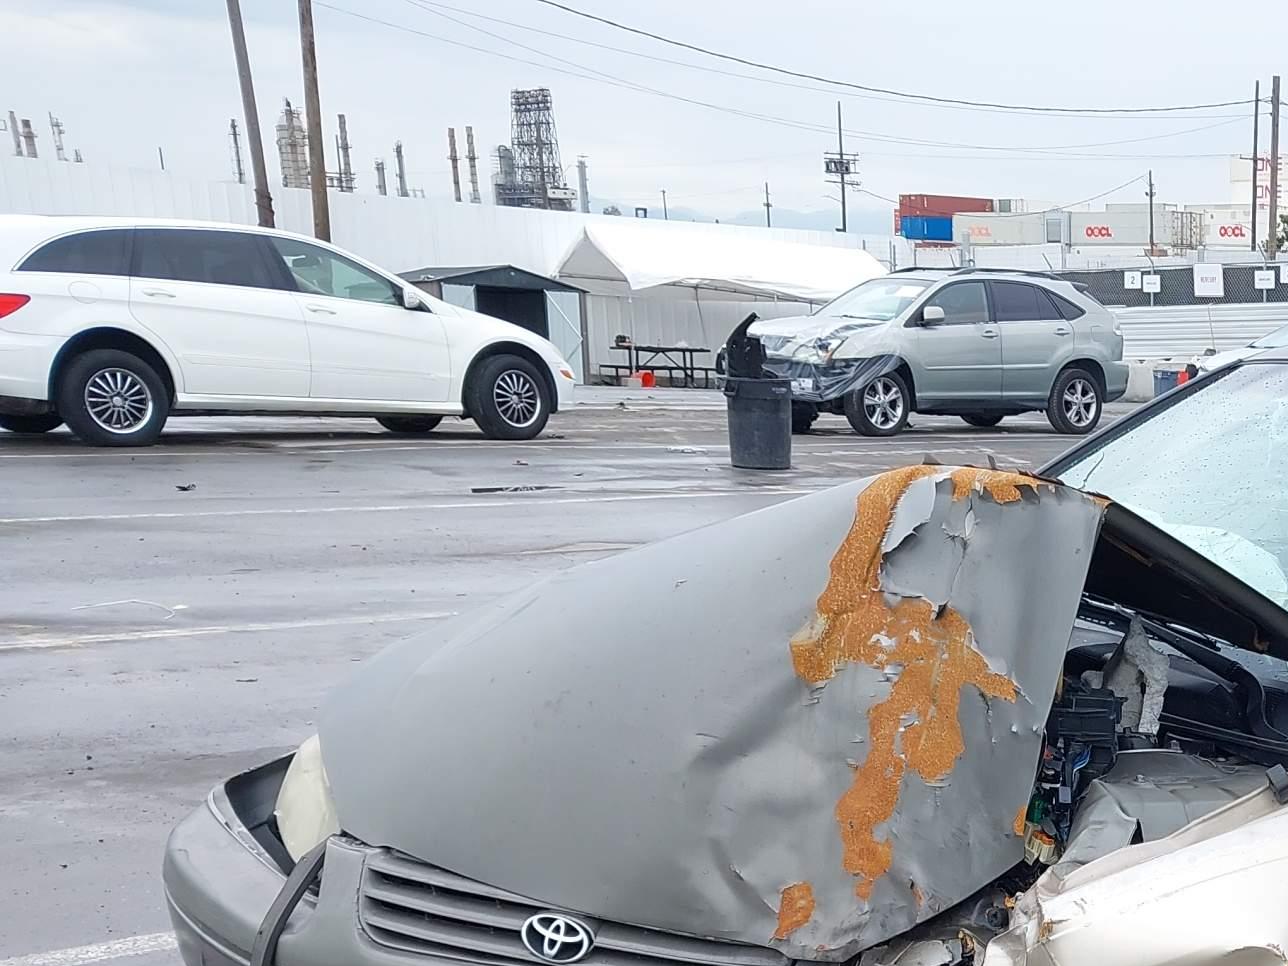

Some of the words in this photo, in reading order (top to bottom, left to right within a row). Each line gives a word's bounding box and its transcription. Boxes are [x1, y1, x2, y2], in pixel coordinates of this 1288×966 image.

[1085, 226, 1112, 238] OOCL
[1219, 225, 1246, 238] OOCL
[1130, 275, 1136, 285] 2
